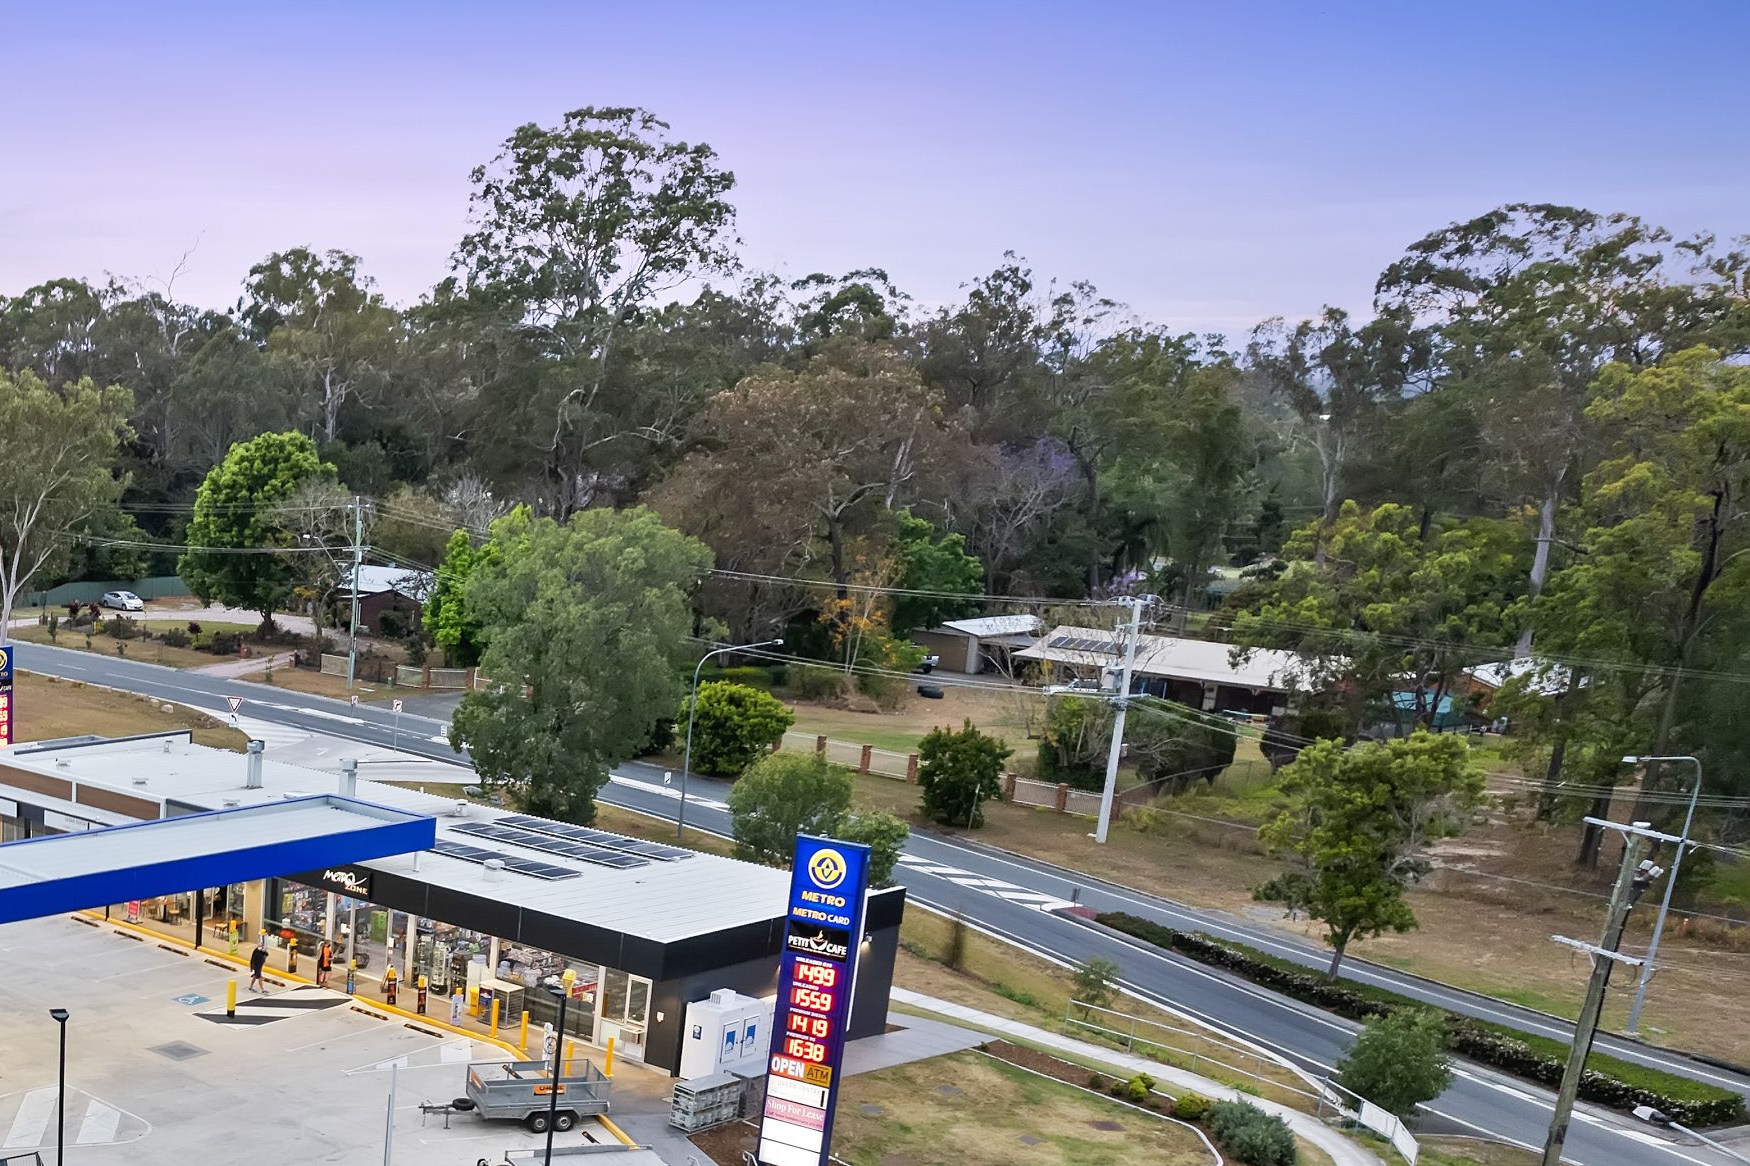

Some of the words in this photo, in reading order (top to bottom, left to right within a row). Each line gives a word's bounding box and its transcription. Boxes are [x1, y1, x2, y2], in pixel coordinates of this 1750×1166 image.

[345, 884, 368, 895] ZONE
[801, 891, 846, 908] METRO
[793, 907, 827, 921] METRO
[827, 914, 850, 926] CARD
[788, 935, 810, 948] PETIT
[826, 943, 847, 956] CAFE
[771, 1056, 805, 1079] OPEN
[807, 1067, 829, 1081] ATM
[766, 1099, 786, 1113] Shop
[787, 1104, 802, 1116] For
[802, 1108, 825, 1121] Lease
